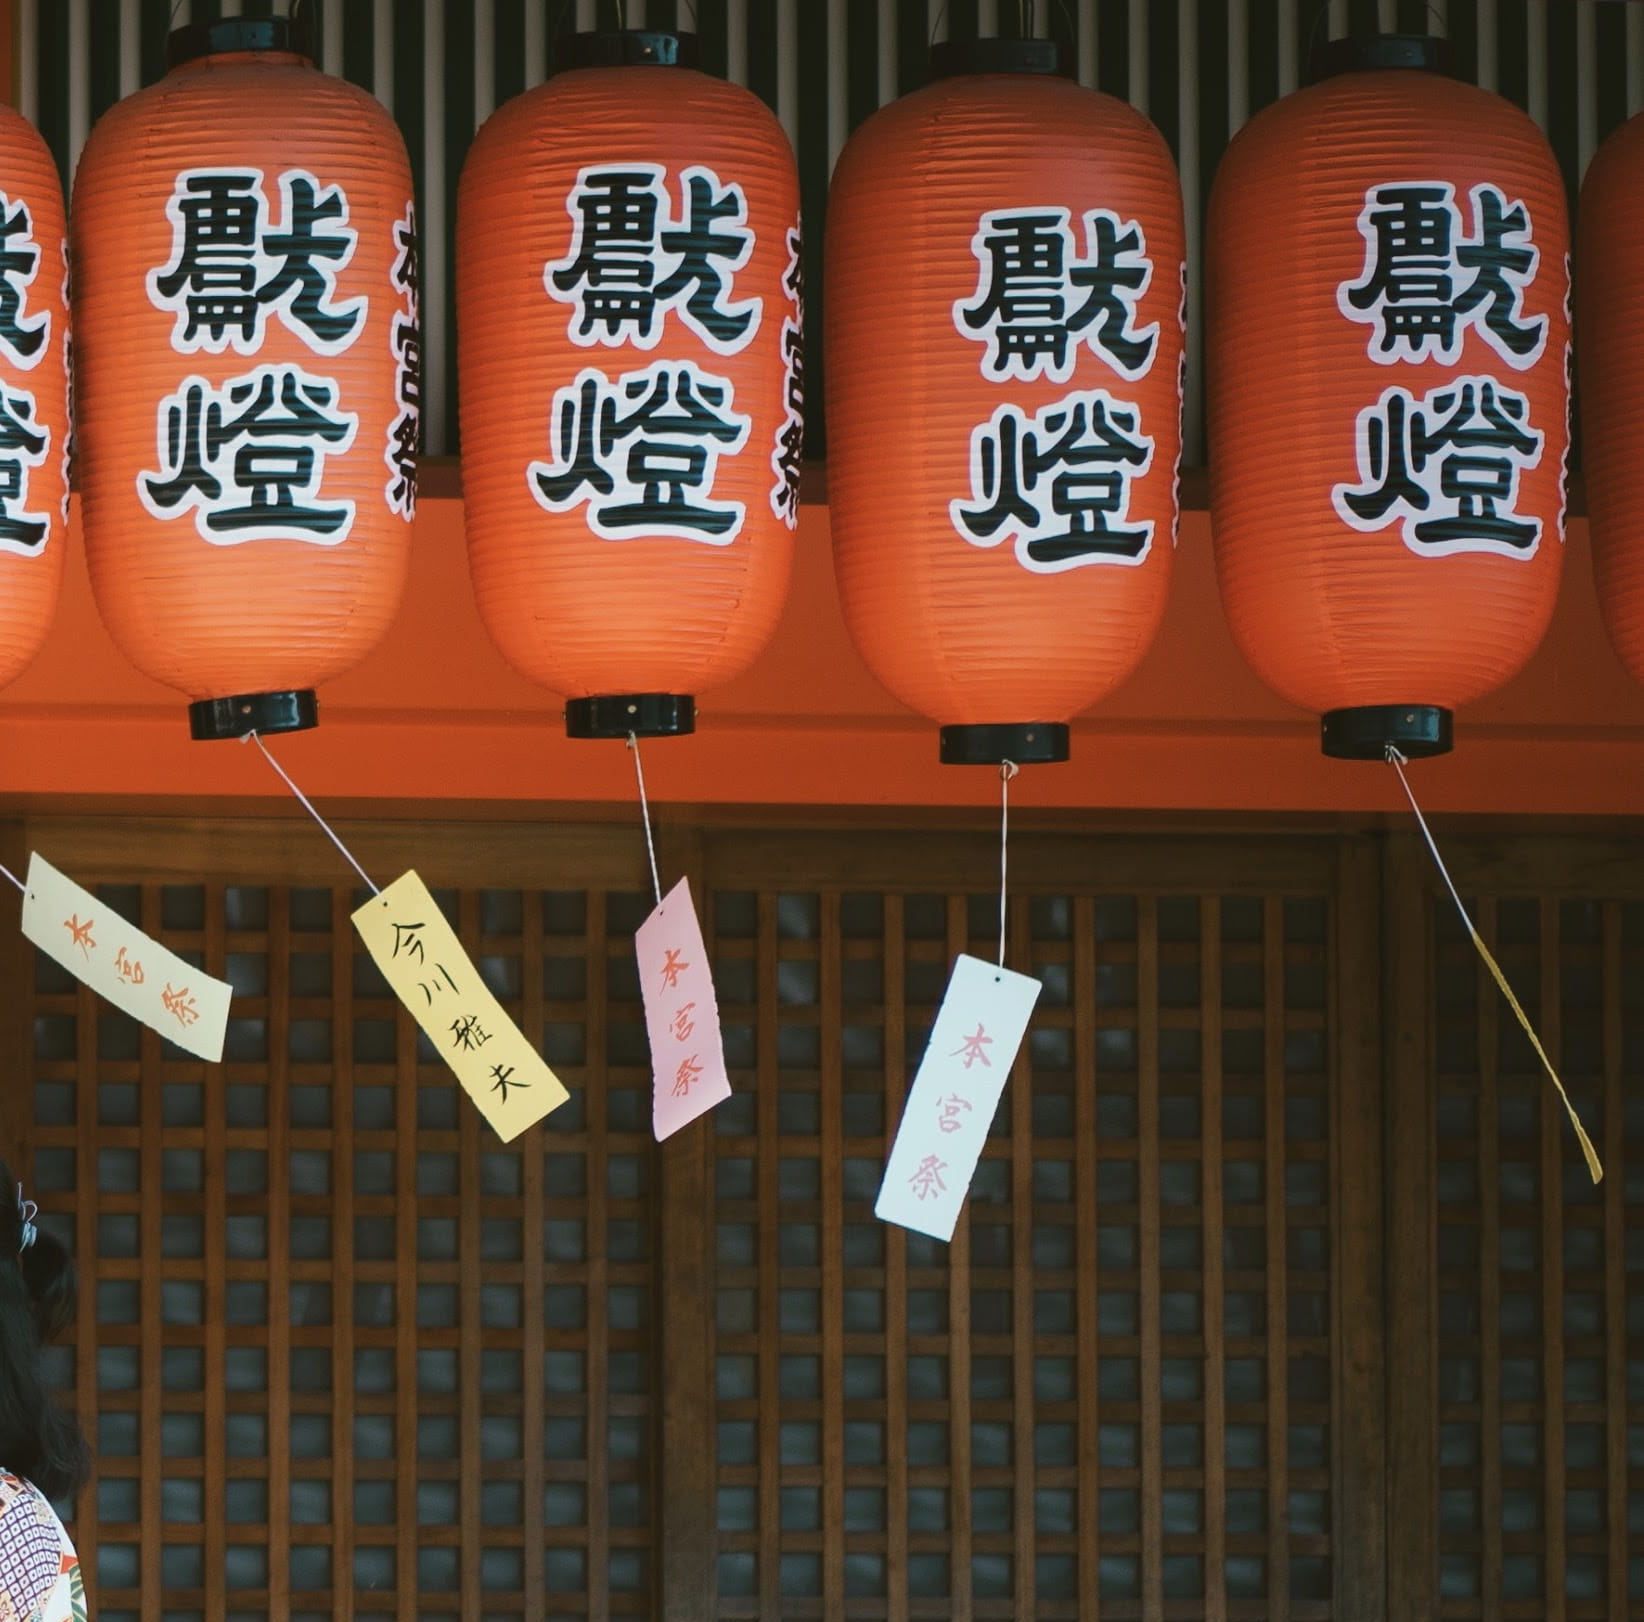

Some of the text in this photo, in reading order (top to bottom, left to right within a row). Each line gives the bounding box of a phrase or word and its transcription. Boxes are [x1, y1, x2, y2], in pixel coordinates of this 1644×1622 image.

[63, 912, 202, 1028] 本宮祭
[390, 922, 533, 1105] 今川雅夫
[658, 947, 705, 1099] 本宮祭
[906, 1021, 996, 1202] 本宮祭
